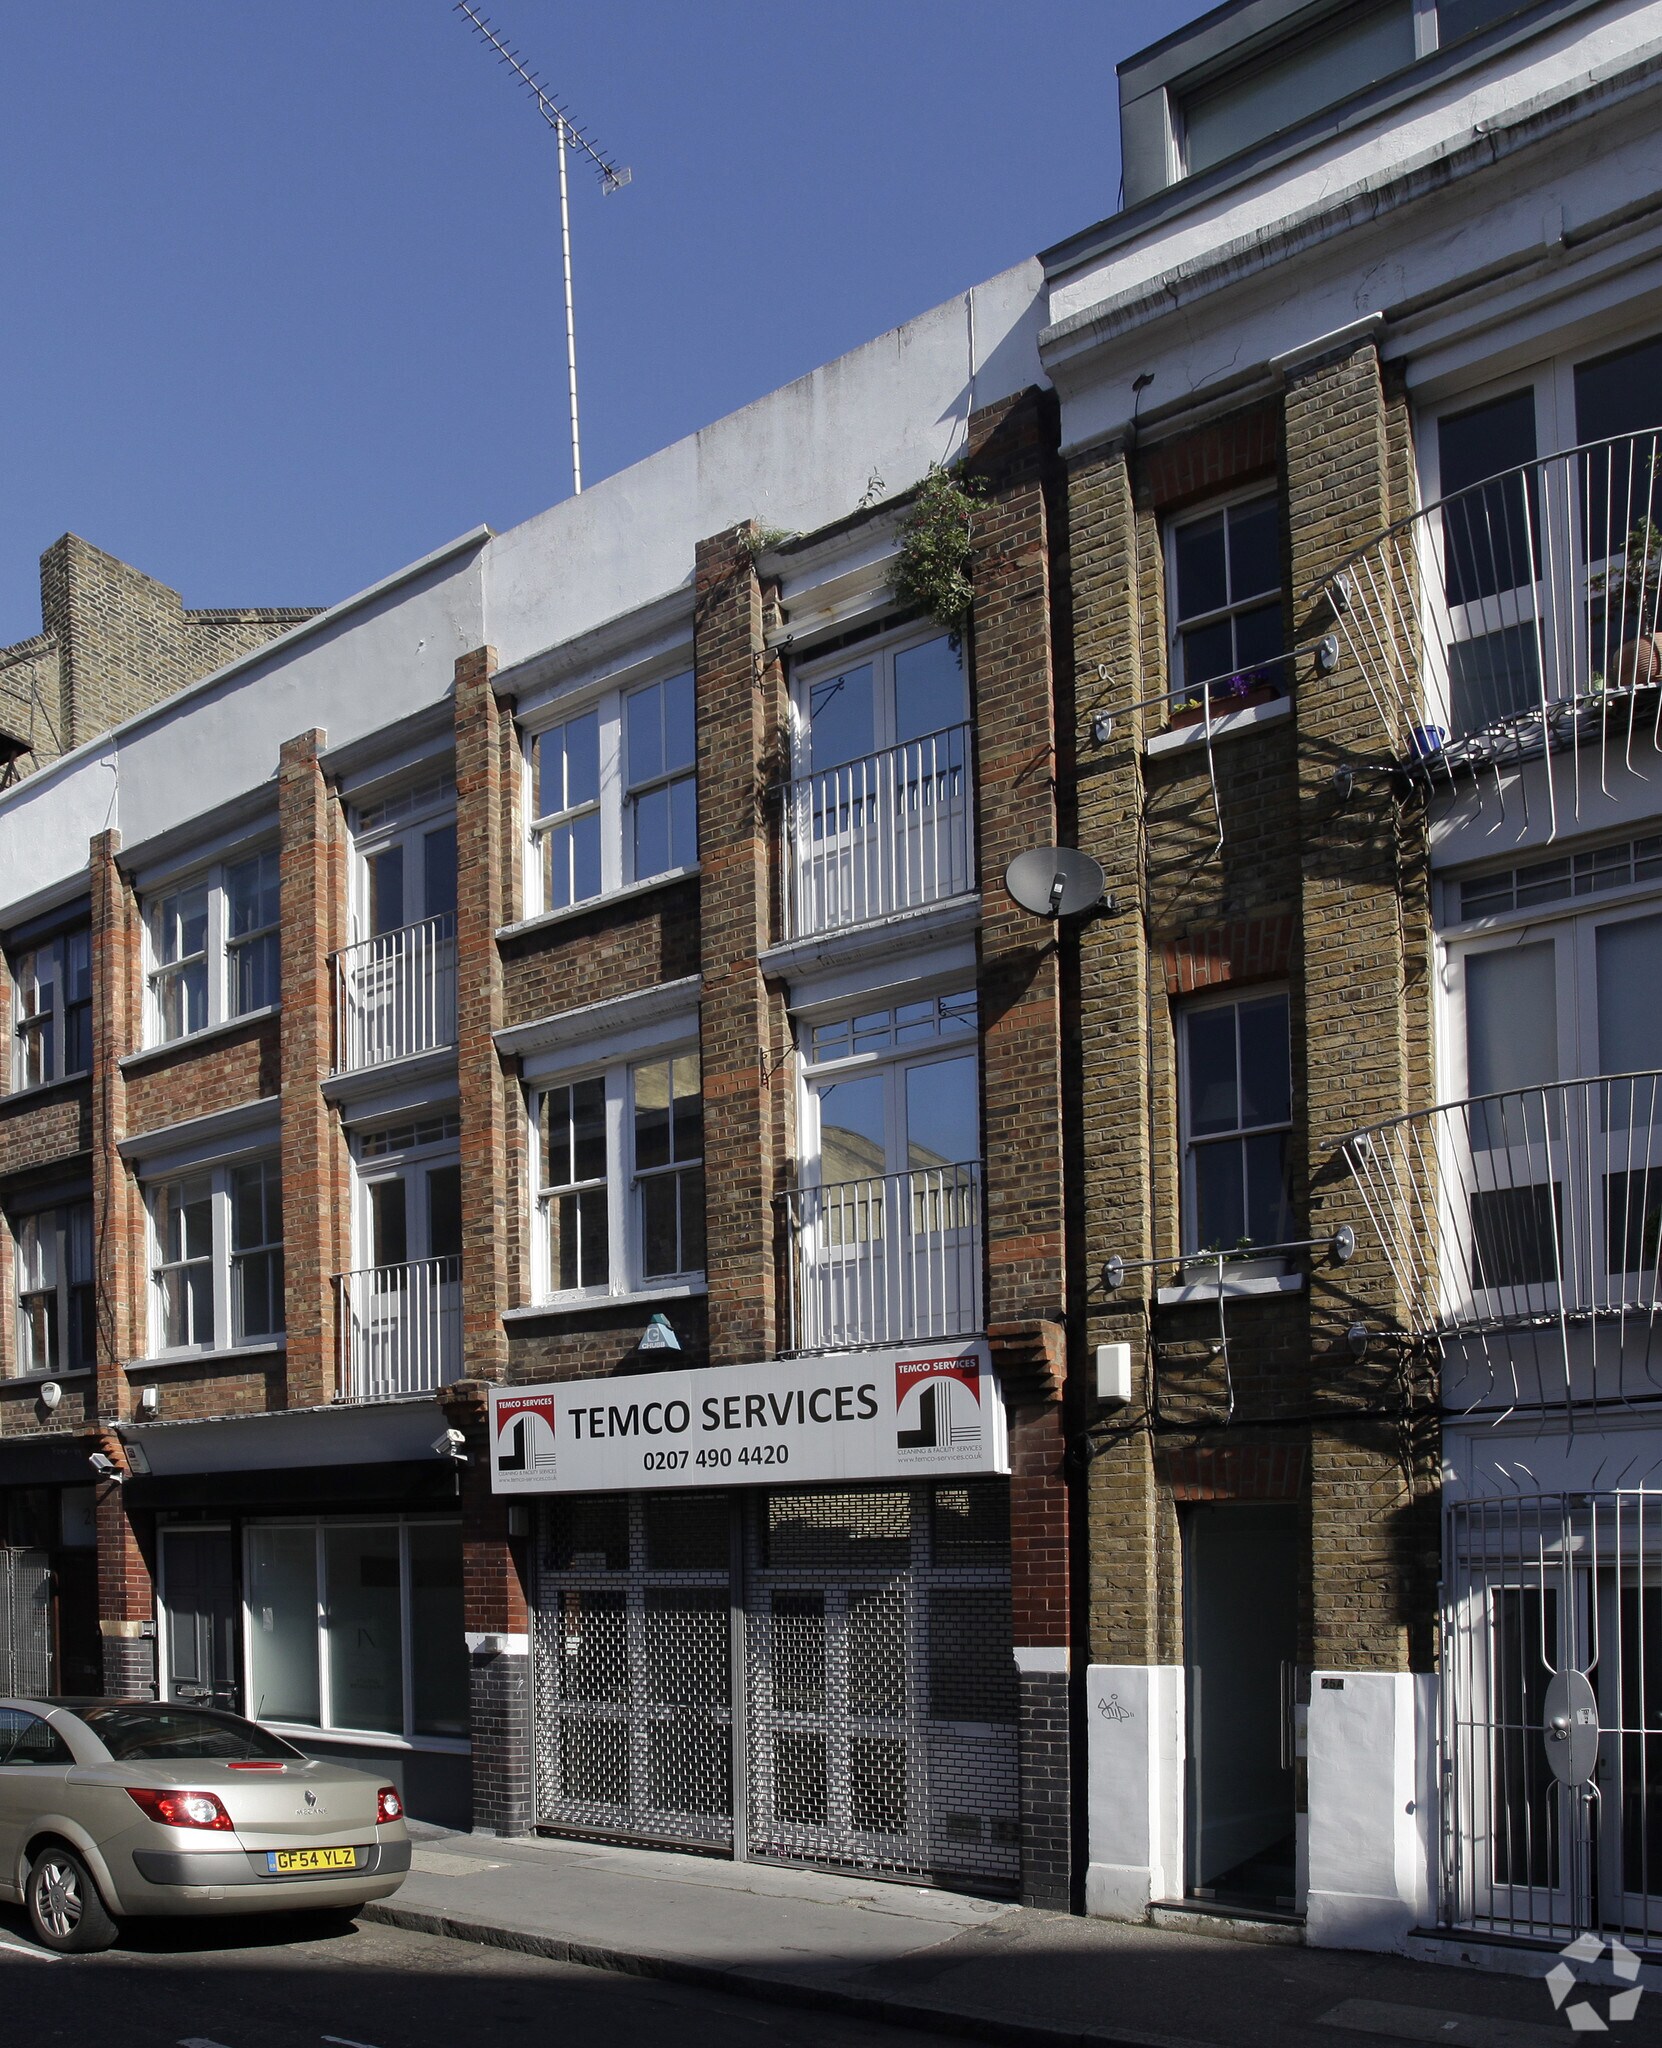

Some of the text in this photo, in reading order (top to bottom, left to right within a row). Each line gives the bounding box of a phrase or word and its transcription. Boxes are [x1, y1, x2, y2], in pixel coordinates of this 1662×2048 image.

[641, 1341, 665, 1349] CHUBB
[898, 1359, 976, 1373] TEMCO SERVICES
[498, 1398, 552, 1409] TEMCO SERVICES
[568, 1384, 878, 1439] TEMCO SERVICES
[897, 1447, 926, 1455] CLEANING
[643, 1444, 789, 1470] 0207 490 4420
[897, 1452, 982, 1463] www.temco-services.co.uk
[1322, 1679, 1343, 1689] 25A
[278, 1849, 352, 1868] GF54 YLZ
